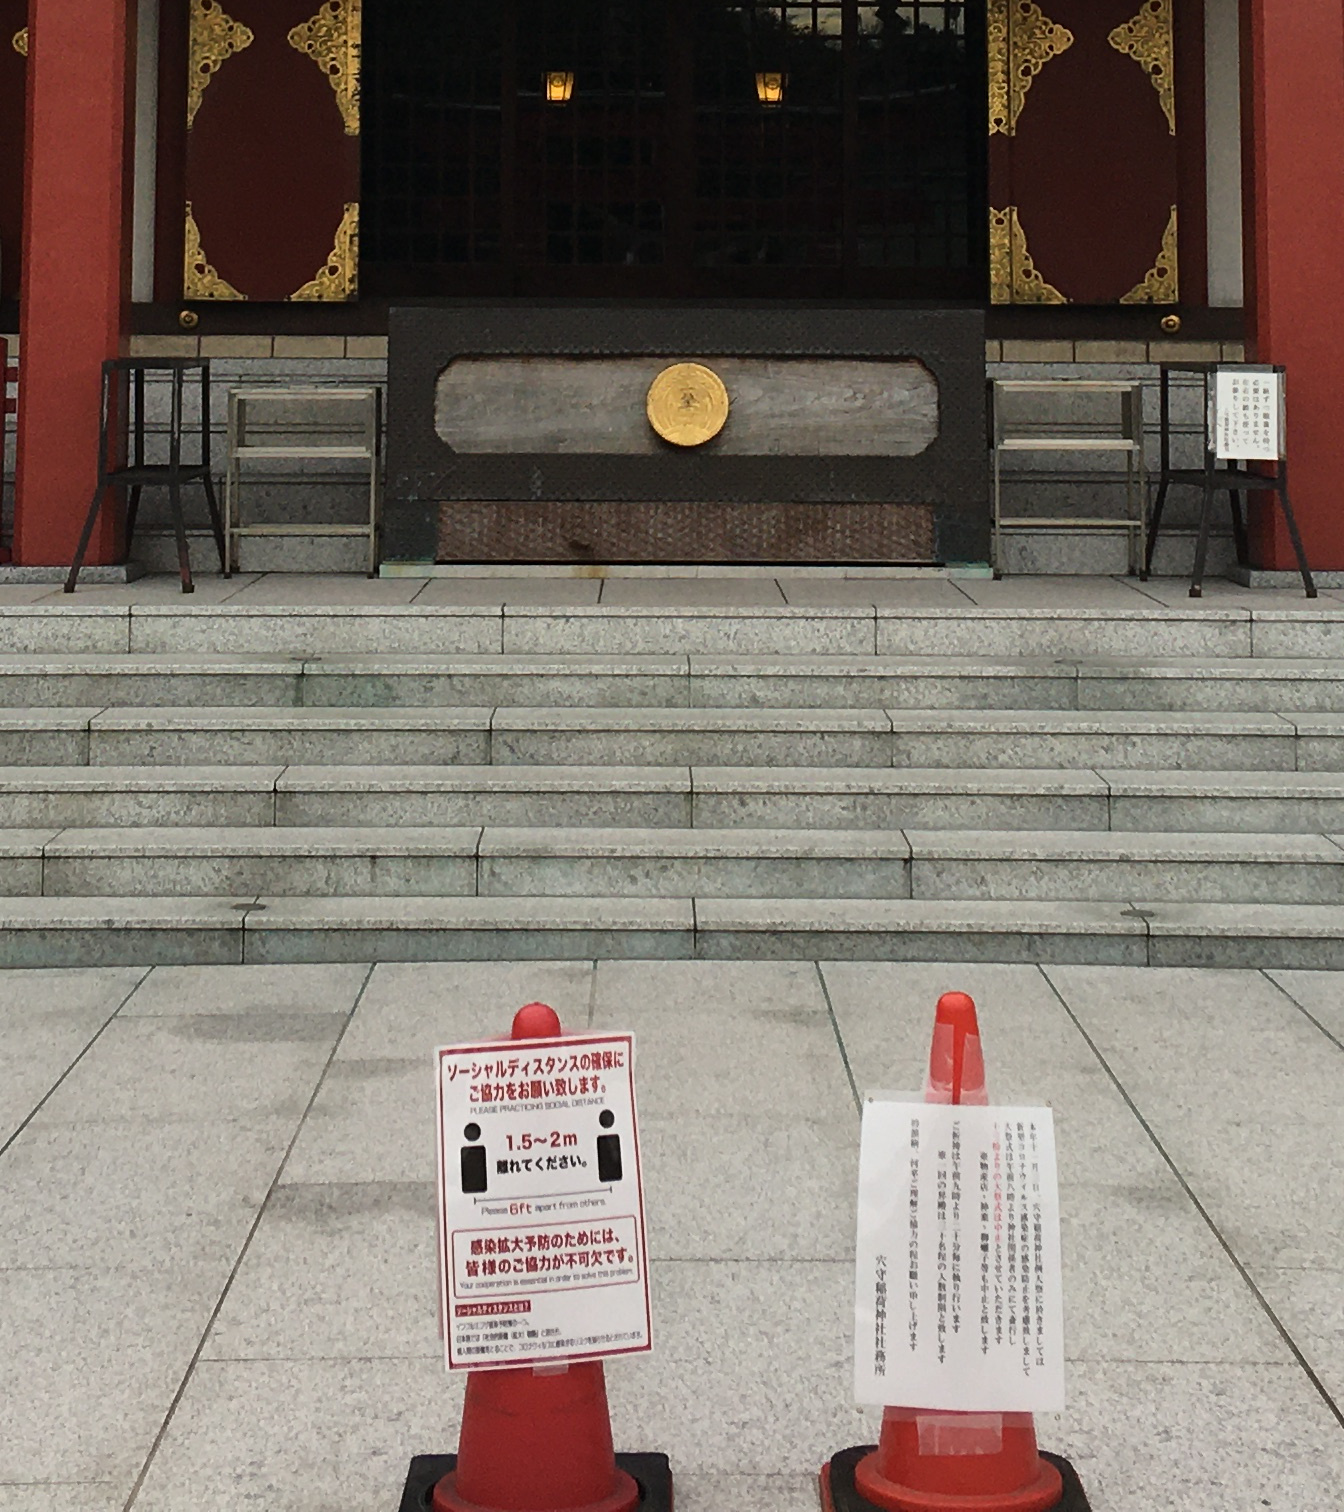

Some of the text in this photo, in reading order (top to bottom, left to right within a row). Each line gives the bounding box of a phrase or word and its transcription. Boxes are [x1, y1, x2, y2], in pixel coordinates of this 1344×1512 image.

[447, 1050, 624, 1082] ソーシャルディスタンスの確保に
[469, 1075, 607, 1103] ご協力をお願い致します。
[496, 1154, 587, 1175] 離れてください。
[509, 1202, 532, 1215] 6ft
[470, 1227, 621, 1256] 感染拡大予防のためには、
[465, 1246, 634, 1278] 皆様のご協力が不可欠です。
